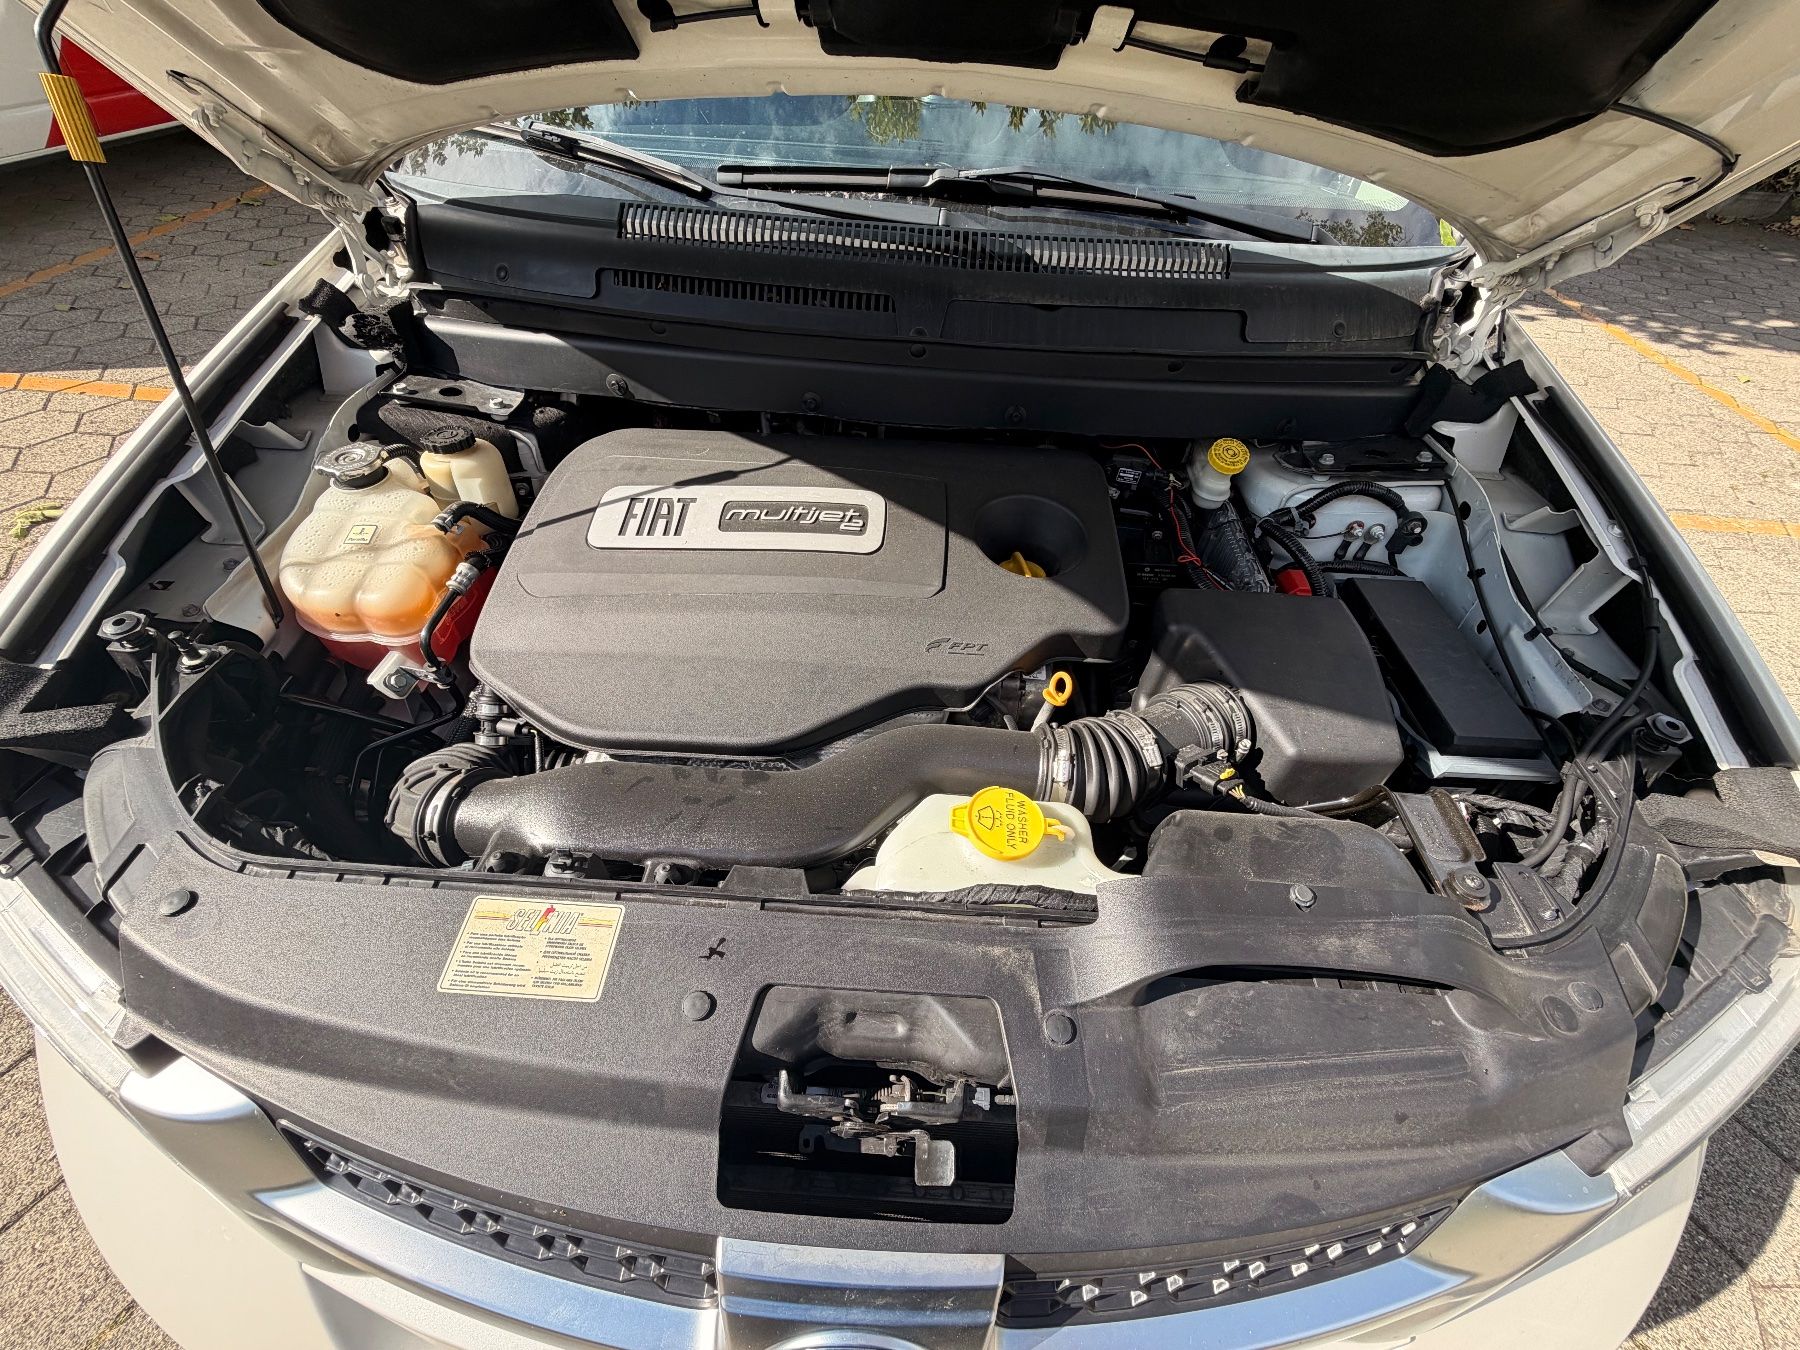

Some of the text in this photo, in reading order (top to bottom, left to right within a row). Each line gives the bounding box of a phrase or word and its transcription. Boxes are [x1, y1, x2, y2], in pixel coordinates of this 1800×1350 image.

[617, 497, 697, 537] FIAT
[1005, 792, 1018, 850] FLUID ONLY
[1017, 800, 1028, 844] WASHER
